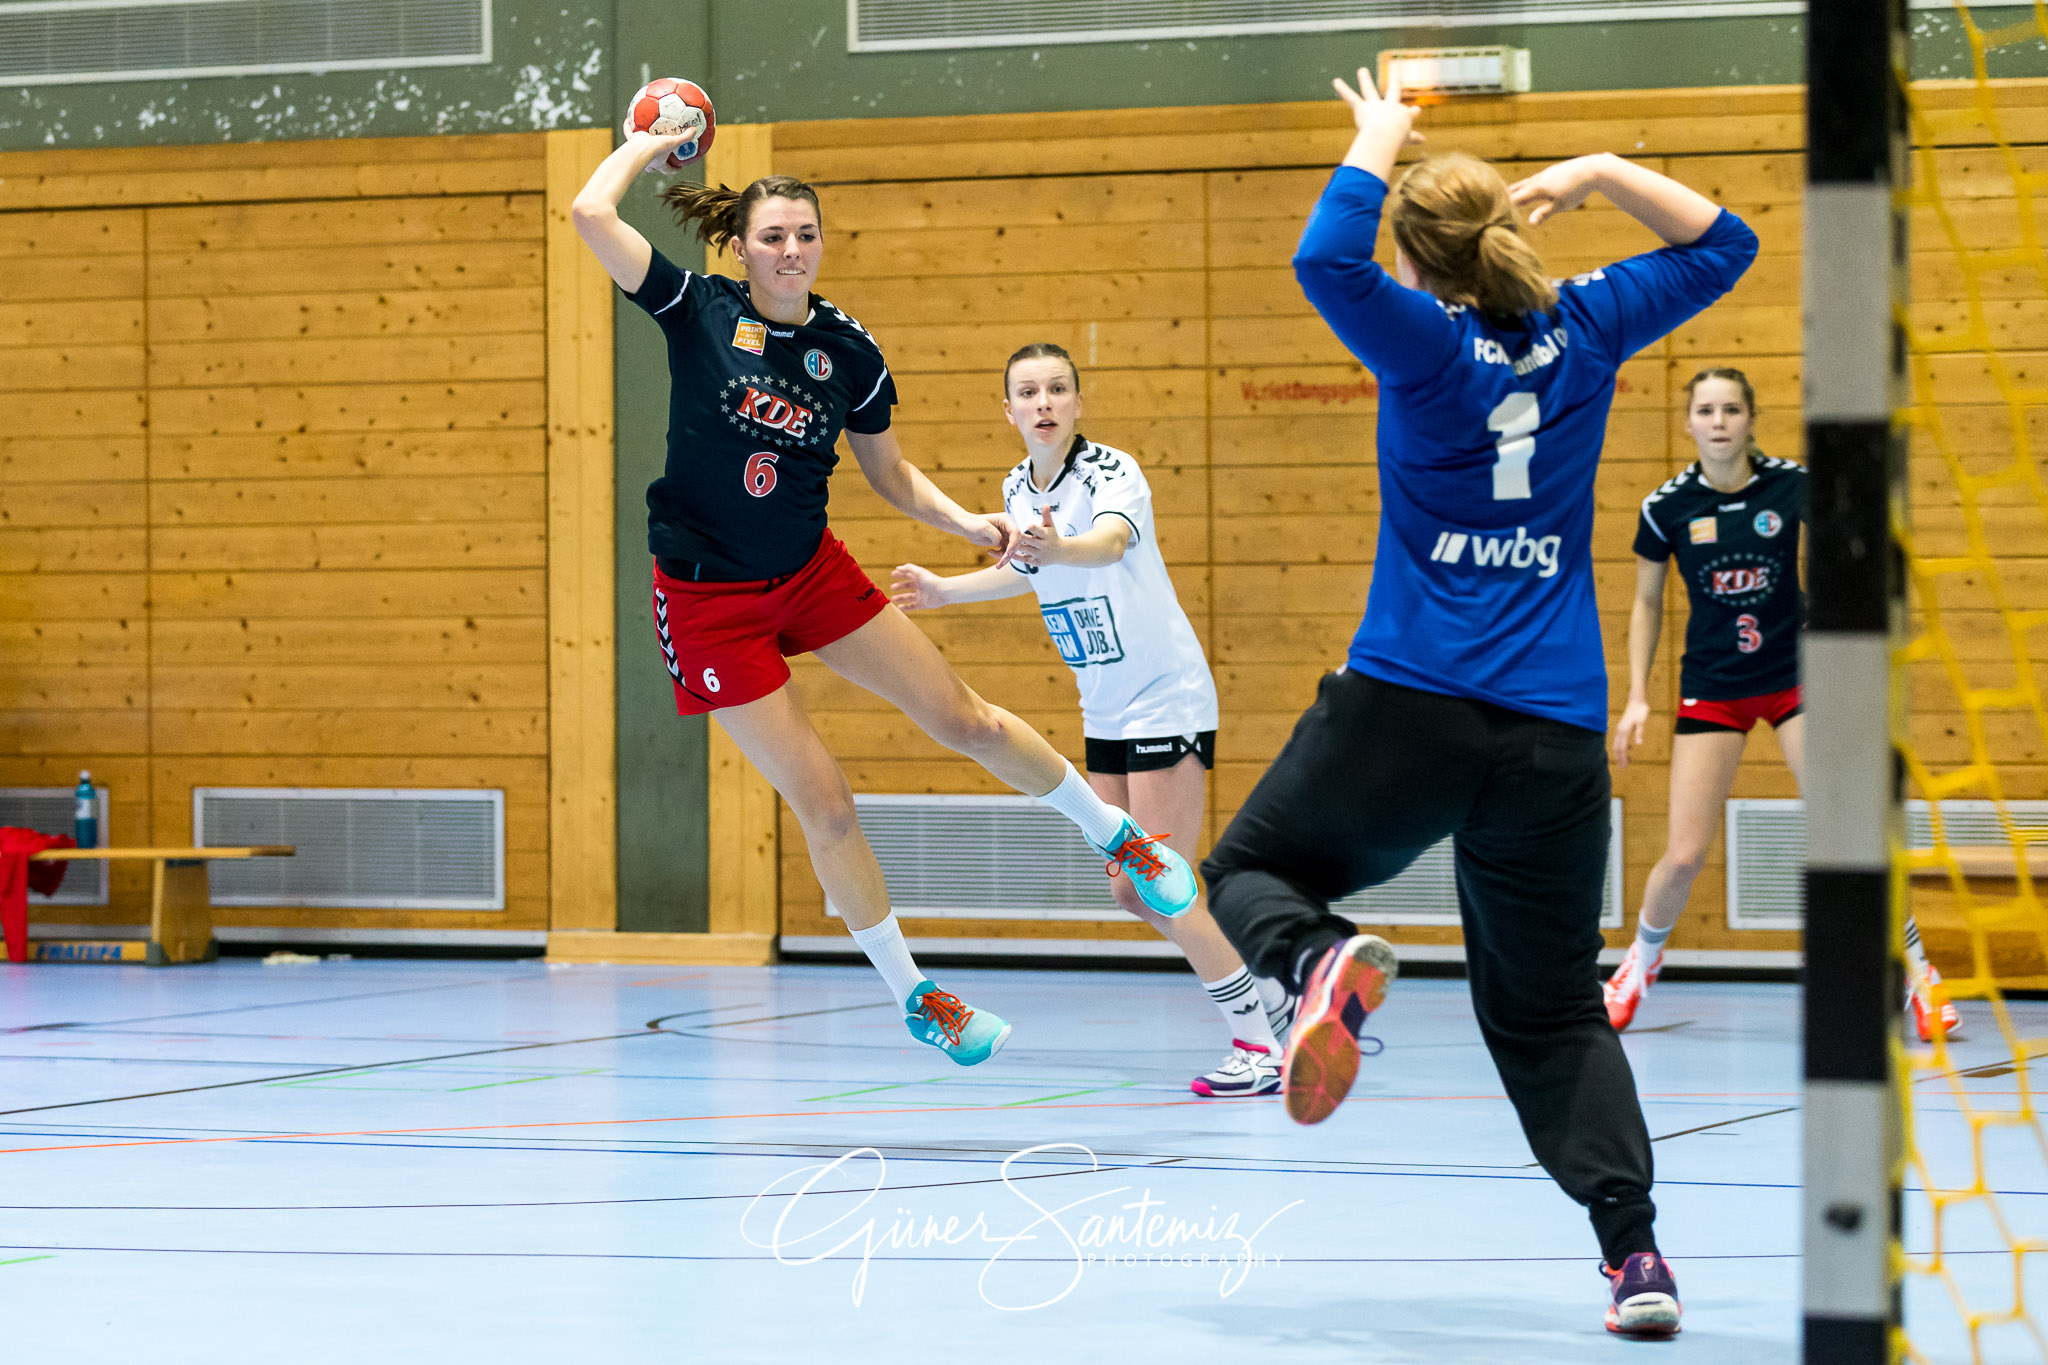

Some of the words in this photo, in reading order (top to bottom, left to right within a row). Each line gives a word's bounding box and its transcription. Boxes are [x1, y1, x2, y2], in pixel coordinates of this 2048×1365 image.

[737, 337, 761, 346] PIXEL
[740, 325, 763, 333] PRINT
[736, 386, 814, 439] KDE
[1487, 392, 1540, 500] 1
[743, 451, 780, 498] 6
[1471, 526, 1562, 578] wbg
[1712, 566, 1771, 595] KDE
[1736, 613, 1763, 654] 3
[702, 667, 721, 693] 6
[1135, 742, 1173, 754] hummel
